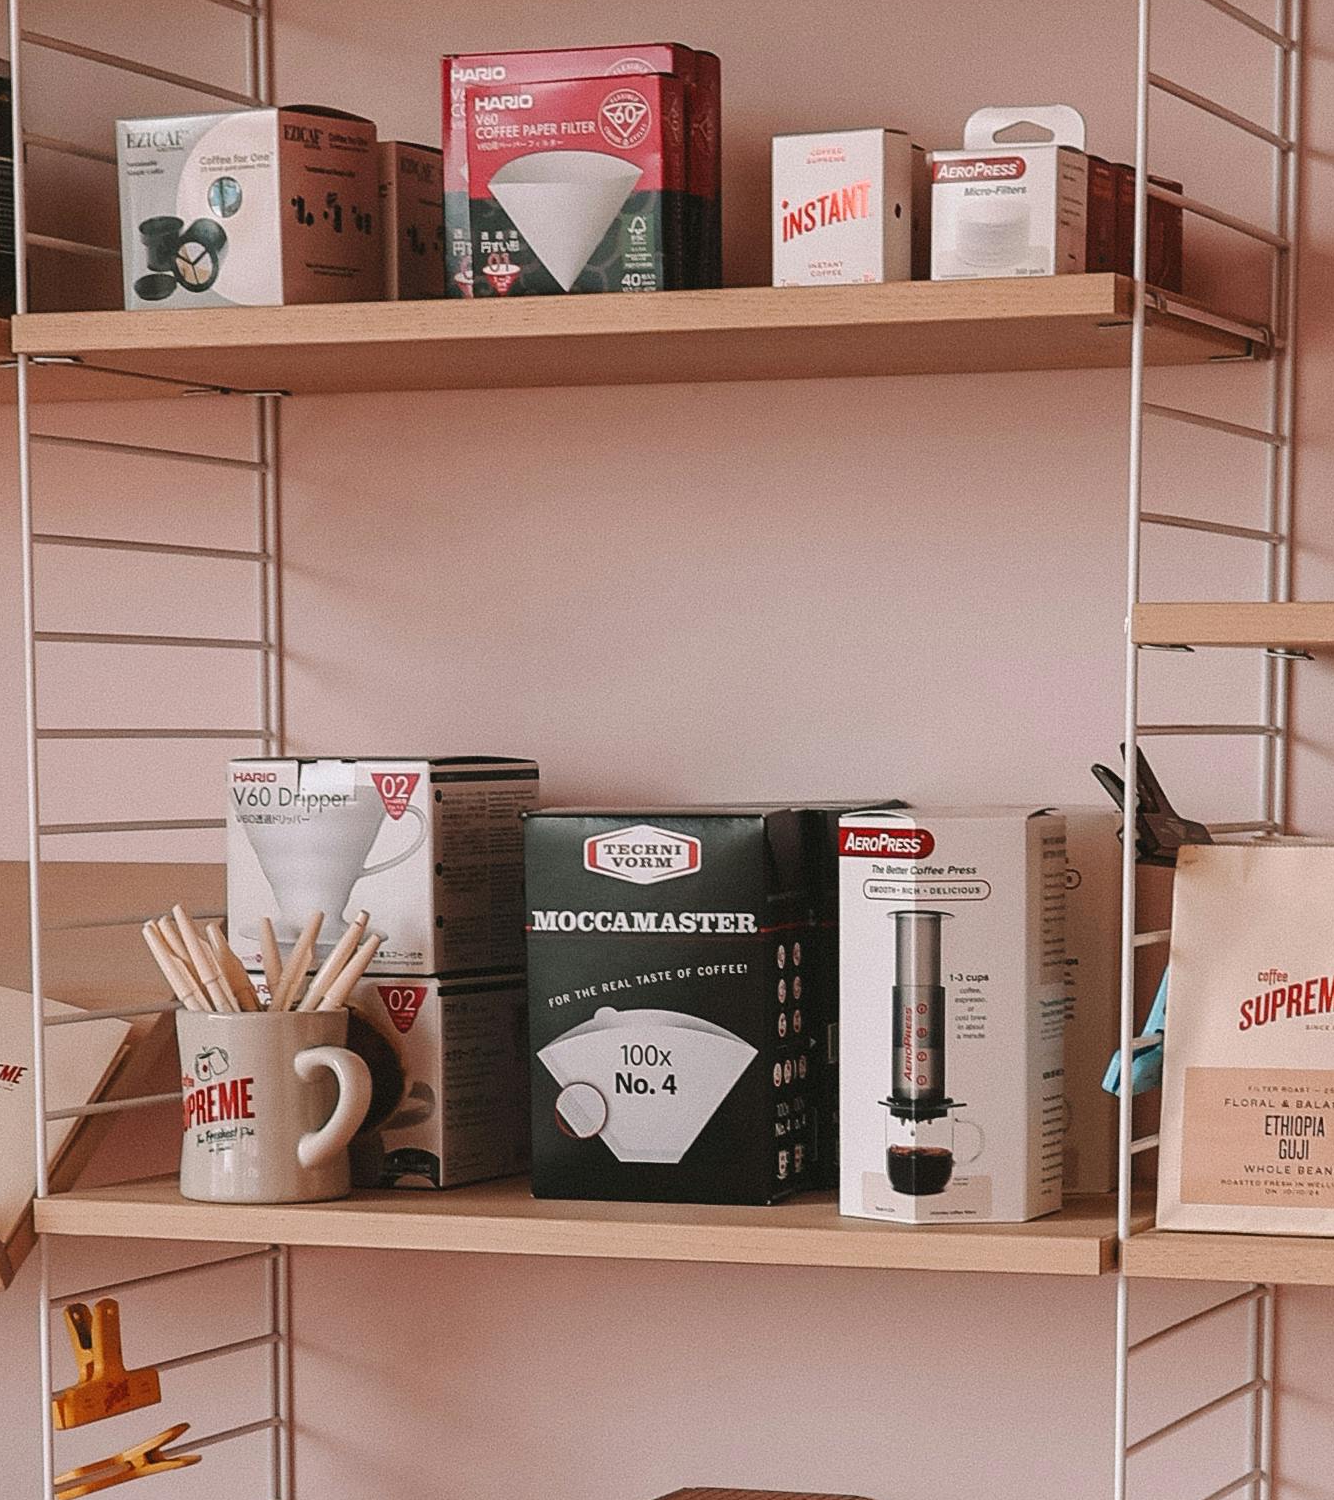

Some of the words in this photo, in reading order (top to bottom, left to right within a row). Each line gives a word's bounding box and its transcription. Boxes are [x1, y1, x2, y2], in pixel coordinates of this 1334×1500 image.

[450, 65, 506, 83] HARIO
[474, 94, 534, 112] HARIO
[475, 113, 499, 126] V60
[475, 125, 520, 140] COFFEE
[522, 123, 558, 137] PAPER
[561, 121, 597, 135] FILTER
[199, 155, 231, 166] Coffee
[233, 153, 247, 164] for
[964, 186, 1028, 197] Micro-Filters
[620, 272, 641, 287] 40
[232, 772, 278, 784] HARIO
[381, 775, 410, 799] 02
[233, 786, 272, 808] V60
[278, 786, 351, 813] Dripper
[603, 843, 683, 857] TECHNI
[610, 856, 675, 869] VORM
[871, 864, 885, 874] The
[886, 865, 908, 875] Better
[910, 865, 945, 876] Coffee
[947, 866, 978, 875] Press
[531, 910, 758, 934] MOCCAMASTER
[547, 993, 572, 1009] FOR
[574, 985, 598, 1001] THE
[601, 978, 633, 993] REAL
[635, 970, 674, 986] TASTE
[676, 967, 693, 980] OF
[697, 963, 749, 978] COFFEE!
[949, 973, 964, 982] 1-3
[966, 974, 989, 983] cups
[1257, 969, 1288, 986] coffee
[387, 989, 418, 1012] 02
[620, 1044, 674, 1067] 100x
[614, 1072, 657, 1095] No.
[661, 1074, 678, 1096] 4
[1224, 1098, 1276, 1109] FLORAL
[1281, 1099, 1290, 1109] &
[1264, 1115, 1326, 1138] ETHIOPIA
[1278, 1139, 1310, 1161] GUJI
[1243, 1164, 1292, 1175] WHOLE
